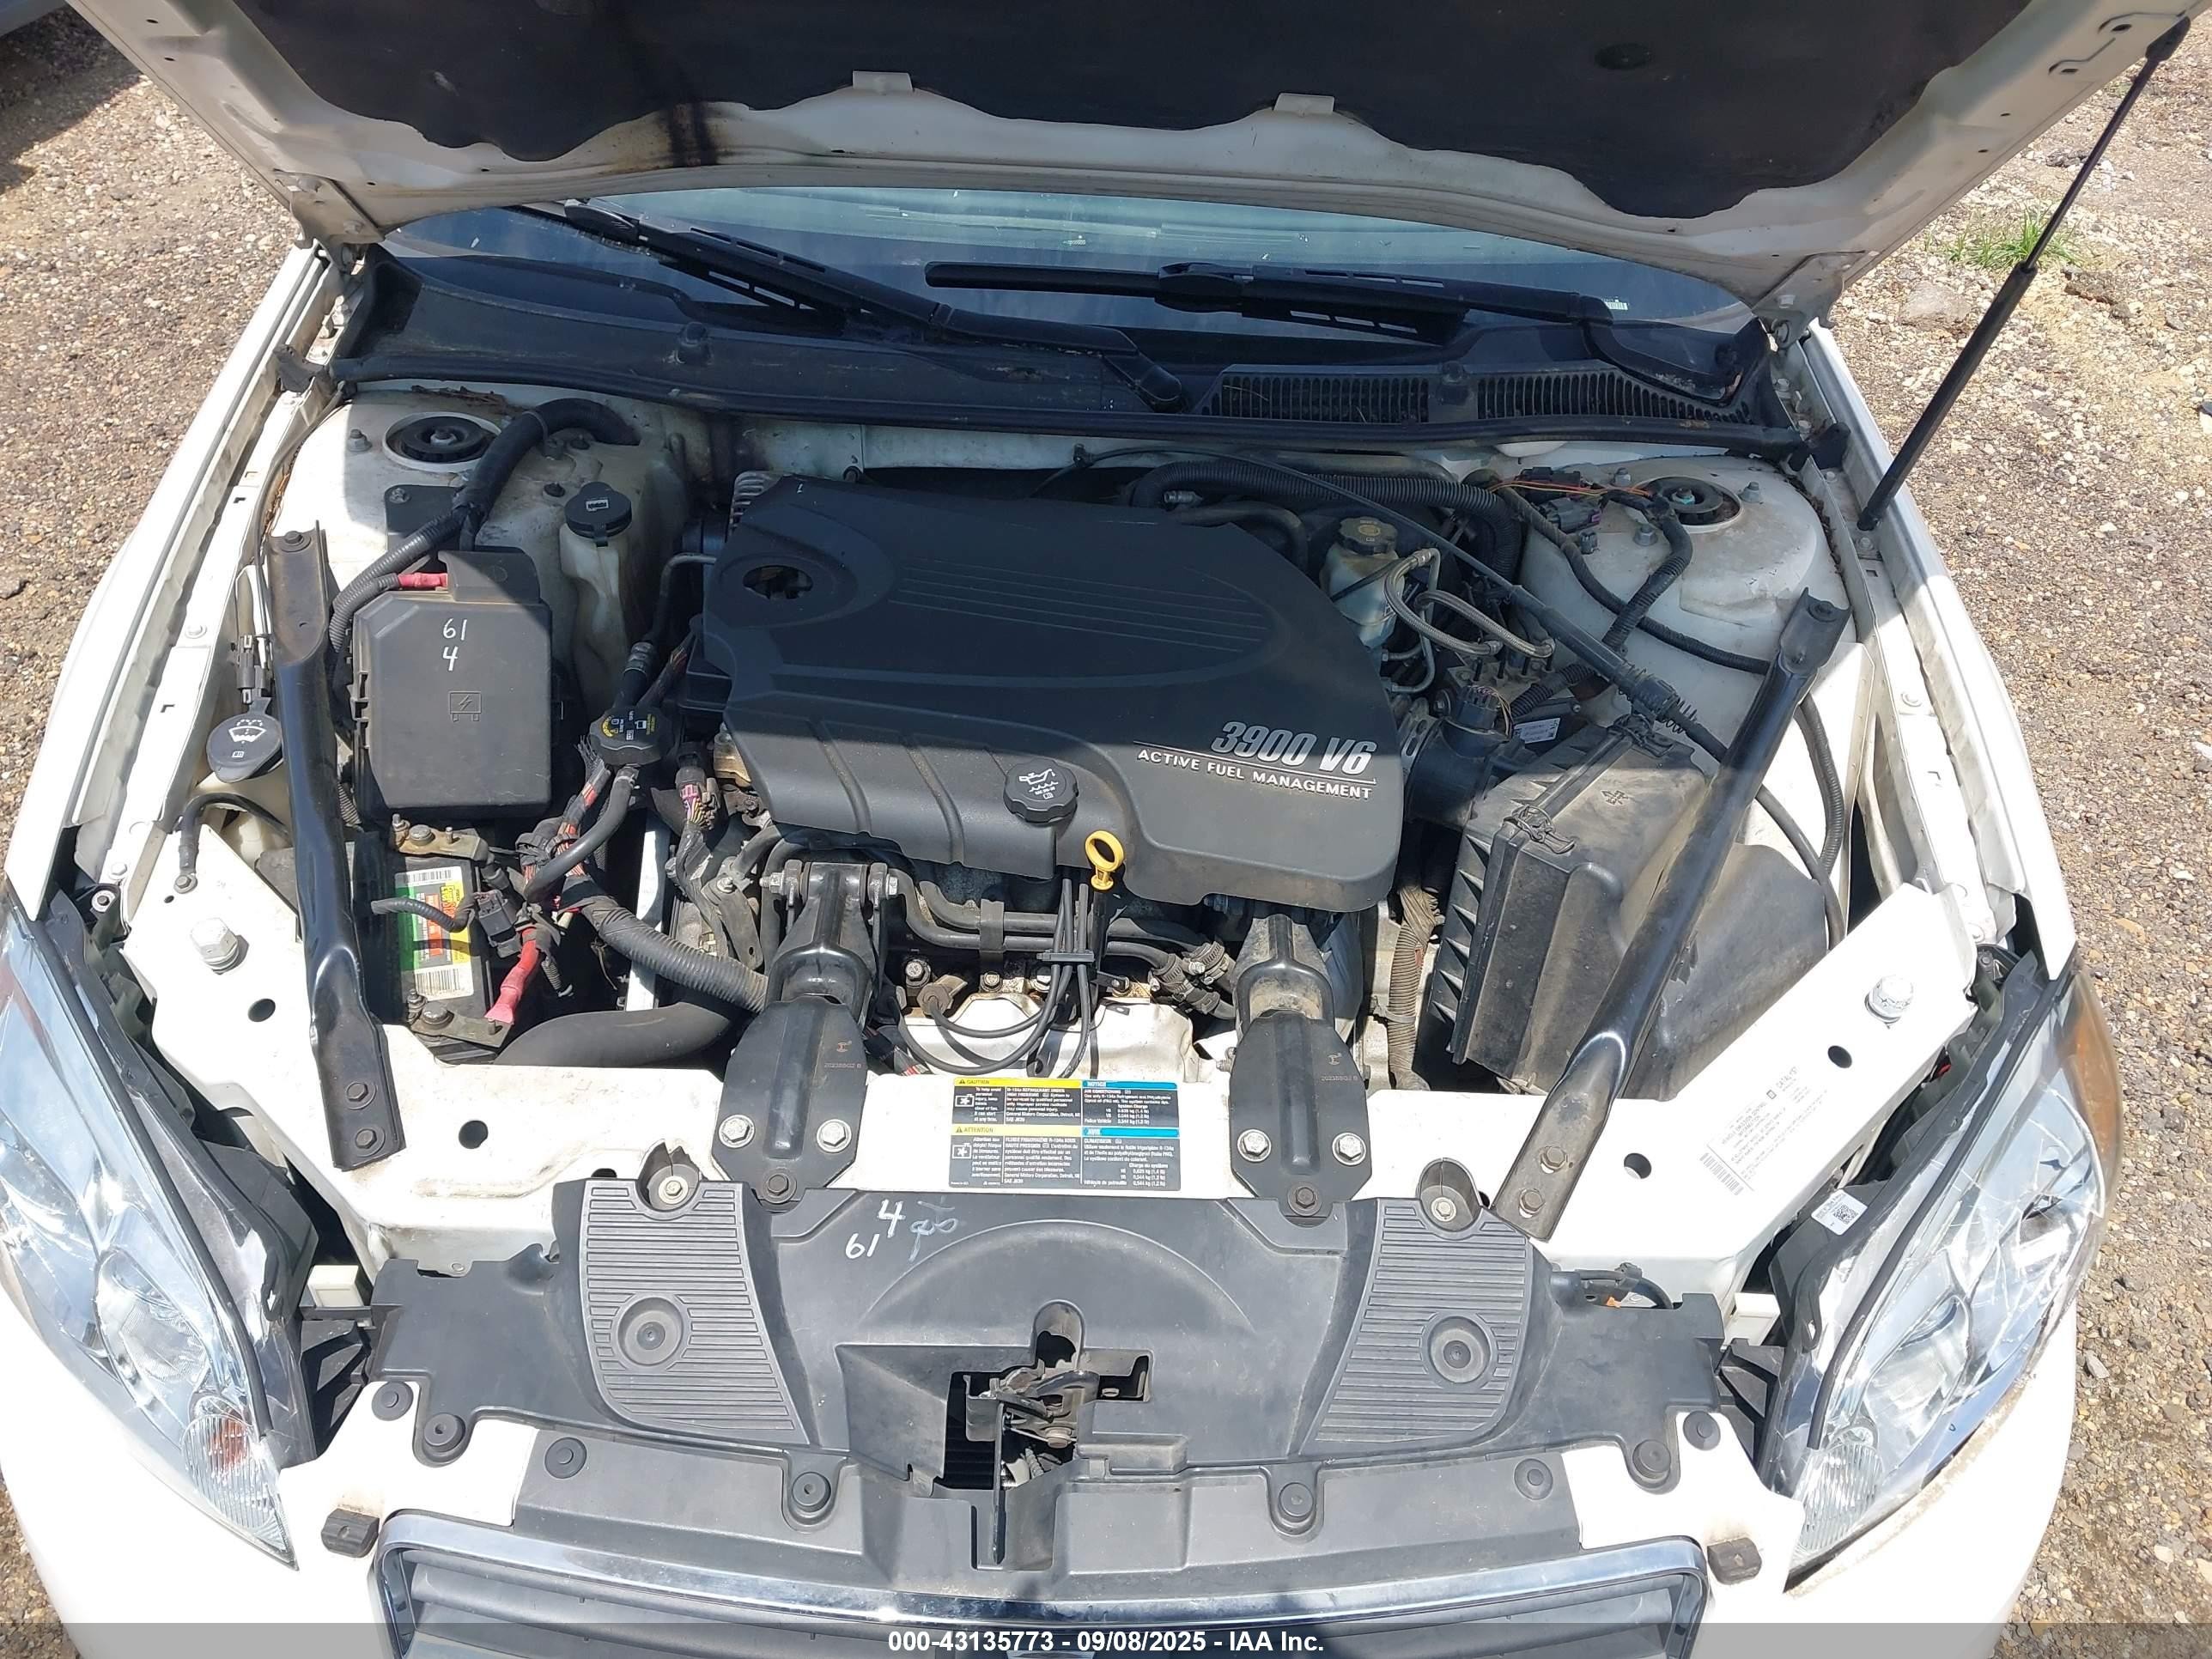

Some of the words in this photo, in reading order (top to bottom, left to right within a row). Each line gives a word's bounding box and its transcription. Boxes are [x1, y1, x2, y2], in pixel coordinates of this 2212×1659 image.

[443, 618, 467, 641] 61
[443, 646, 459, 672] 4
[1212, 722, 1316, 766] 3900
[1319, 738, 1377, 775] V6
[1137, 749, 1200, 770] ACTIVE
[1206, 762, 1245, 779] FUEL
[1252, 770, 1372, 799] MANAGEMENT
[878, 1199, 906, 1238] 4
[845, 1233, 880, 1259] 61
